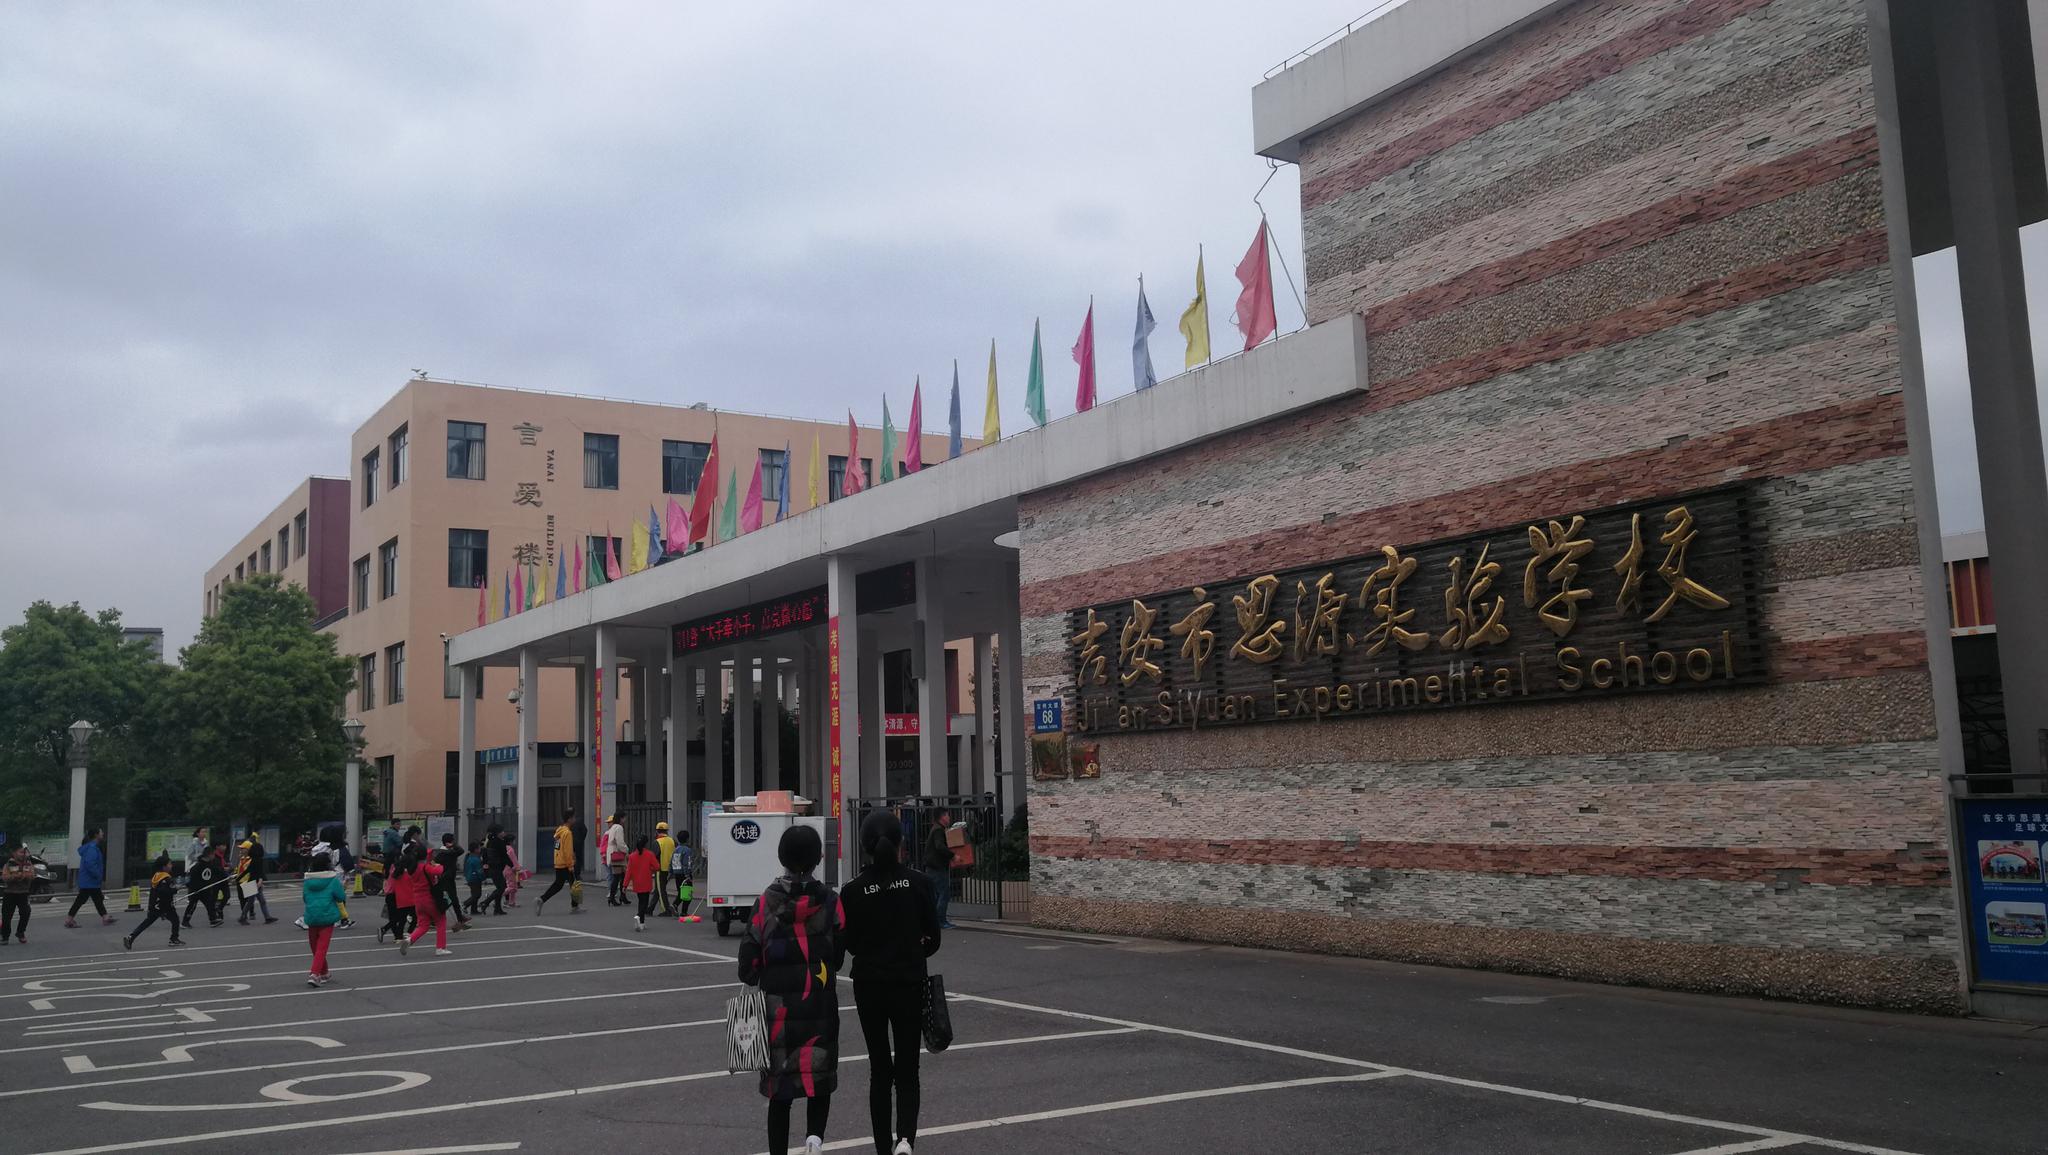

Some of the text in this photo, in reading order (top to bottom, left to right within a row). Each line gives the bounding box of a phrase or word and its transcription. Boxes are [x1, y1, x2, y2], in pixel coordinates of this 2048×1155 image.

[546, 449, 555, 482] YANAI
[1072, 505, 1731, 688] 吉安市思源实验学校
[1557, 630, 1734, 690] School
[1042, 710, 1053, 724] 68
[733, 825, 758, 840] 快递
[62, 1036, 347, 1074] 5
[78, 1071, 432, 1112] 6
